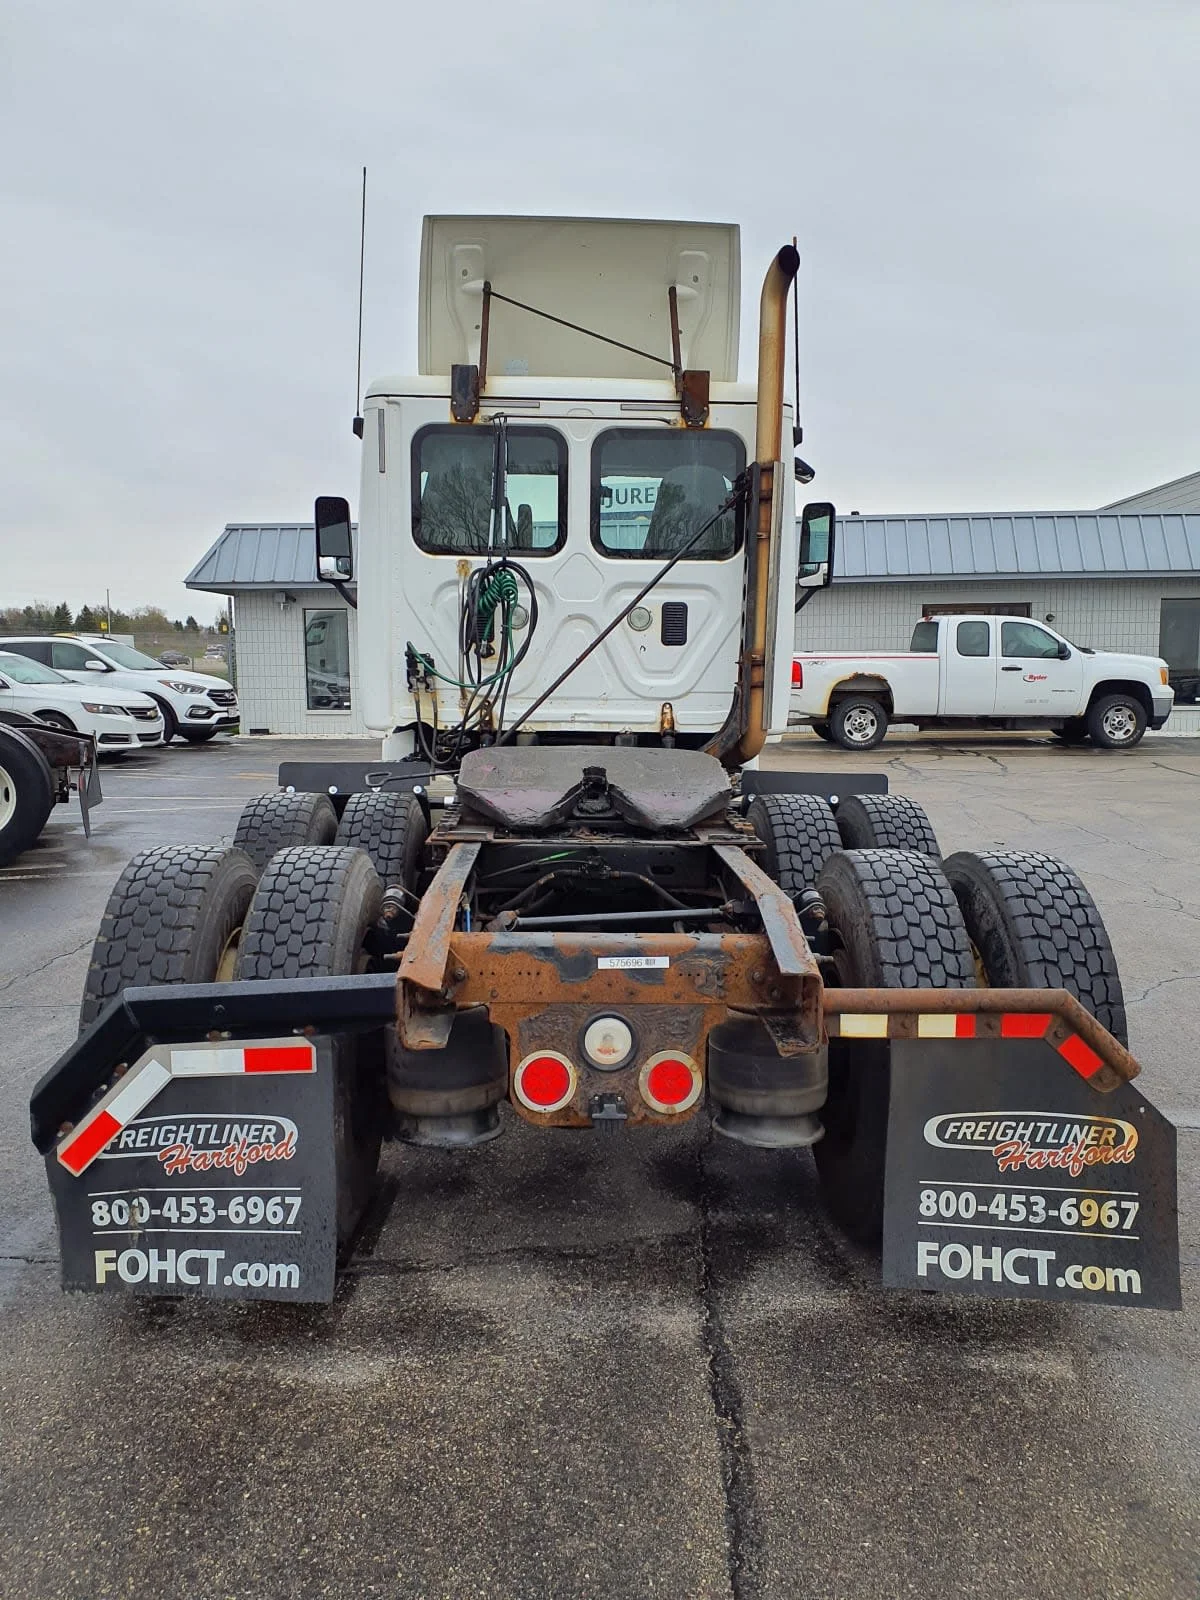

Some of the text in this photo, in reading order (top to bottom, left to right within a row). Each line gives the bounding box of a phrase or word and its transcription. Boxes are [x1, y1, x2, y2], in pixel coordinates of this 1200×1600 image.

[609, 958, 642, 967] 575696
[158, 1130, 297, 1176] Hartford
[944, 1120, 1117, 1145] FREIGHTLINER
[993, 1133, 1136, 1178] Hartford
[91, 1196, 302, 1226] 800-453-6967
[919, 1189, 1140, 1231] 800-453-6967
[94, 1248, 300, 1288] FOHCT.com
[917, 1241, 1142, 1294] FOHCT.com
